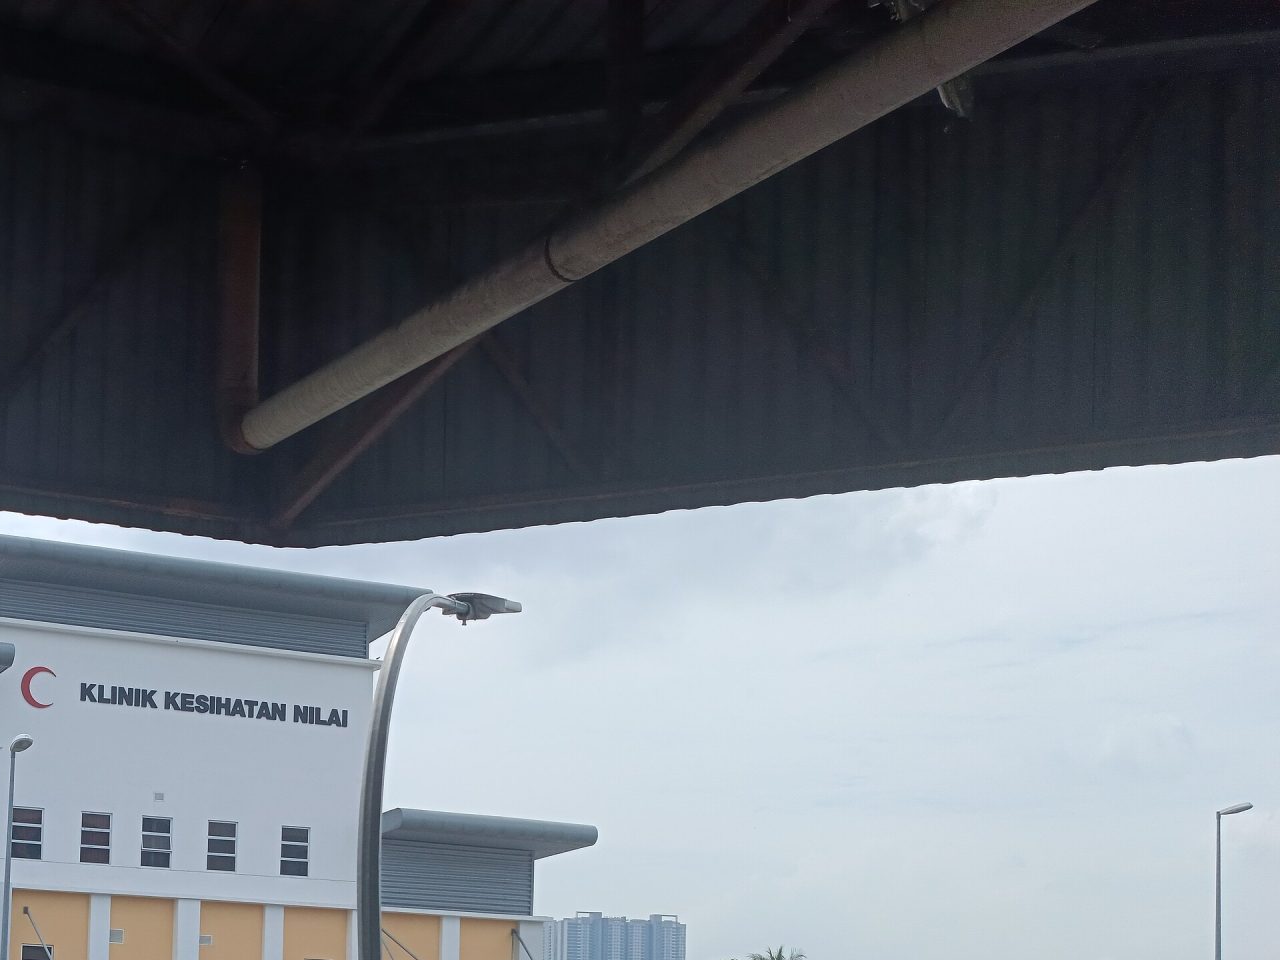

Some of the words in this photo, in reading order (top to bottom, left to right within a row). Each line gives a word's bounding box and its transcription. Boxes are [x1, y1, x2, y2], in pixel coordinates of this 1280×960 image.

[80, 683, 158, 709] KLINIK
[164, 691, 287, 721] KESIHATAN
[293, 704, 348, 728] NILAI
